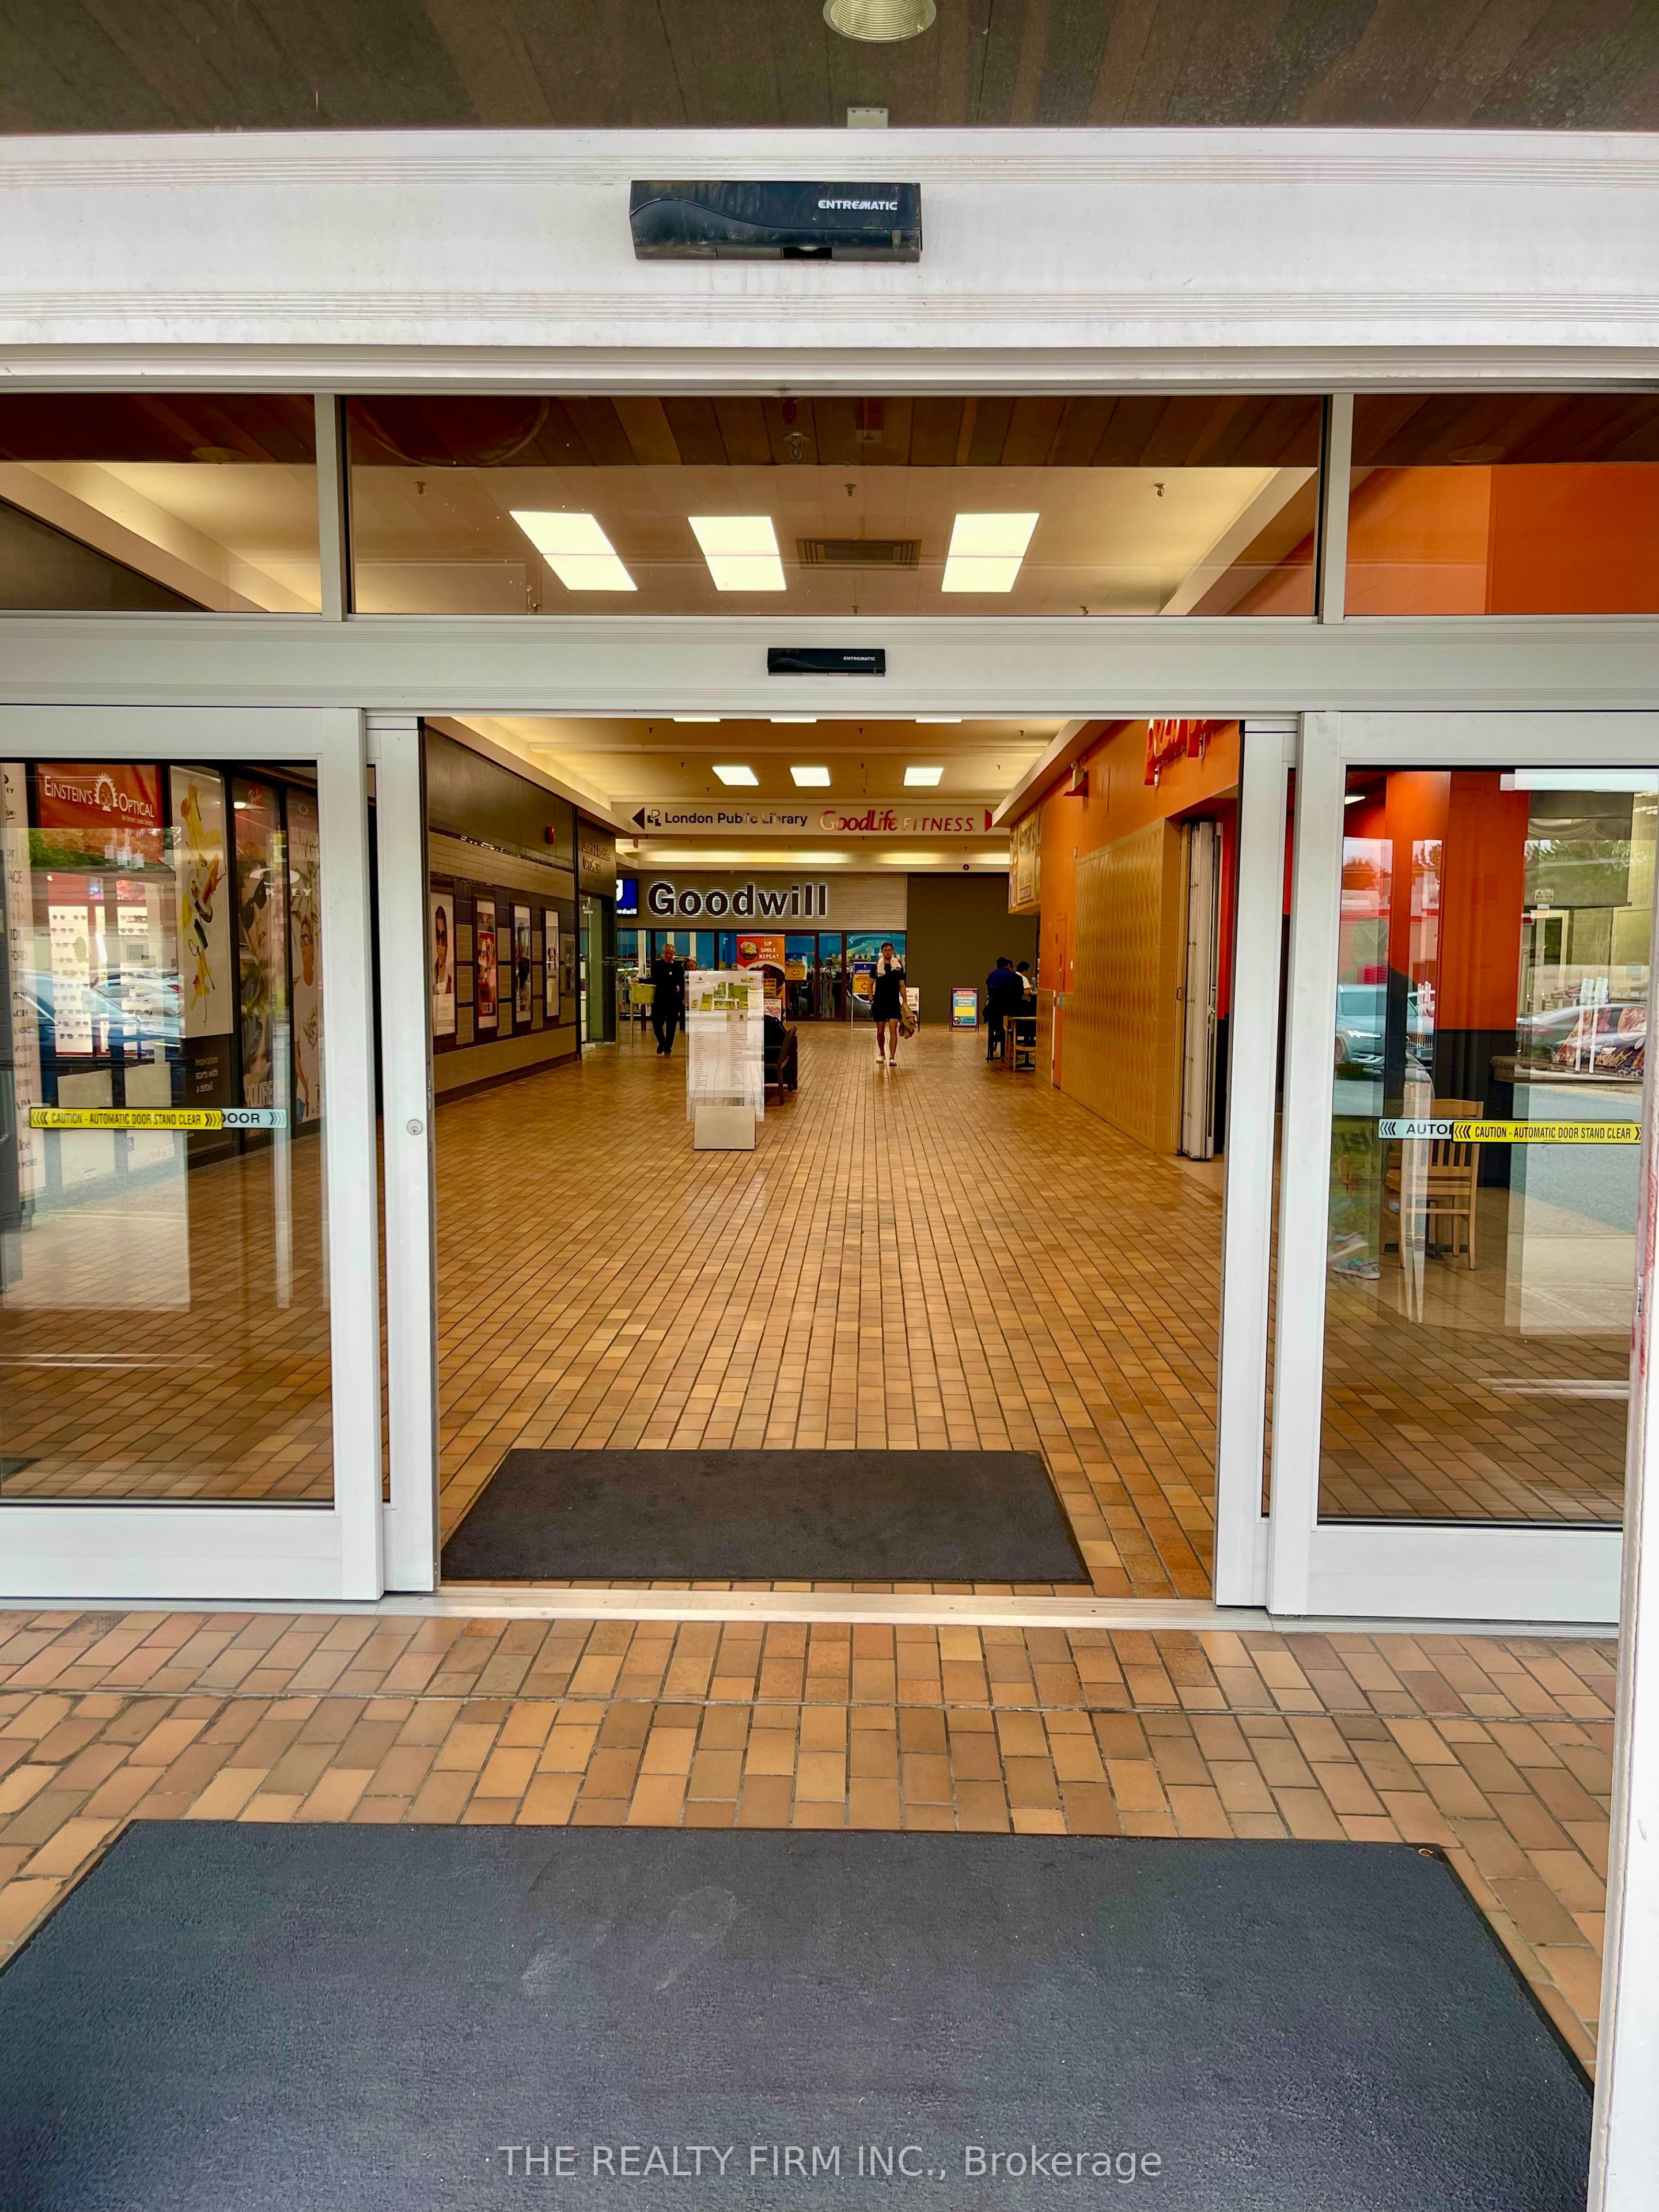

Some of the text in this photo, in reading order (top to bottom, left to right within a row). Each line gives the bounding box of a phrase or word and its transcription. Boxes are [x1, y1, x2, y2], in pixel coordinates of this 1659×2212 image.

[817, 199, 898, 211] ENTREMATIC
[44, 775, 155, 818] EINSTEIN'S OPTICAL
[664, 812, 713, 824] London
[717, 812, 758, 824] Public
[762, 812, 808, 827] Library
[819, 809, 974, 831] GoodLife FITNESS
[647, 882, 827, 916] Goodwill
[51, 1112, 82, 1124] CAUTION
[89, 1113, 129, 1124] AUTOMATIC
[131, 1113, 151, 1124] DOOR
[153, 1113, 177, 1125] STAND
[178, 1114, 202, 1126] CLEAR
[1406, 1123, 1452, 1135] AUTO
[1475, 1126, 1507, 1138] CAUTION
[1514, 1127, 1556, 1138] AUTOMATIC
[1558, 1127, 1579, 1138] DOOR
[1581, 1127, 1605, 1139] STAND
[1607, 1127, 1631, 1139] CLEAR
